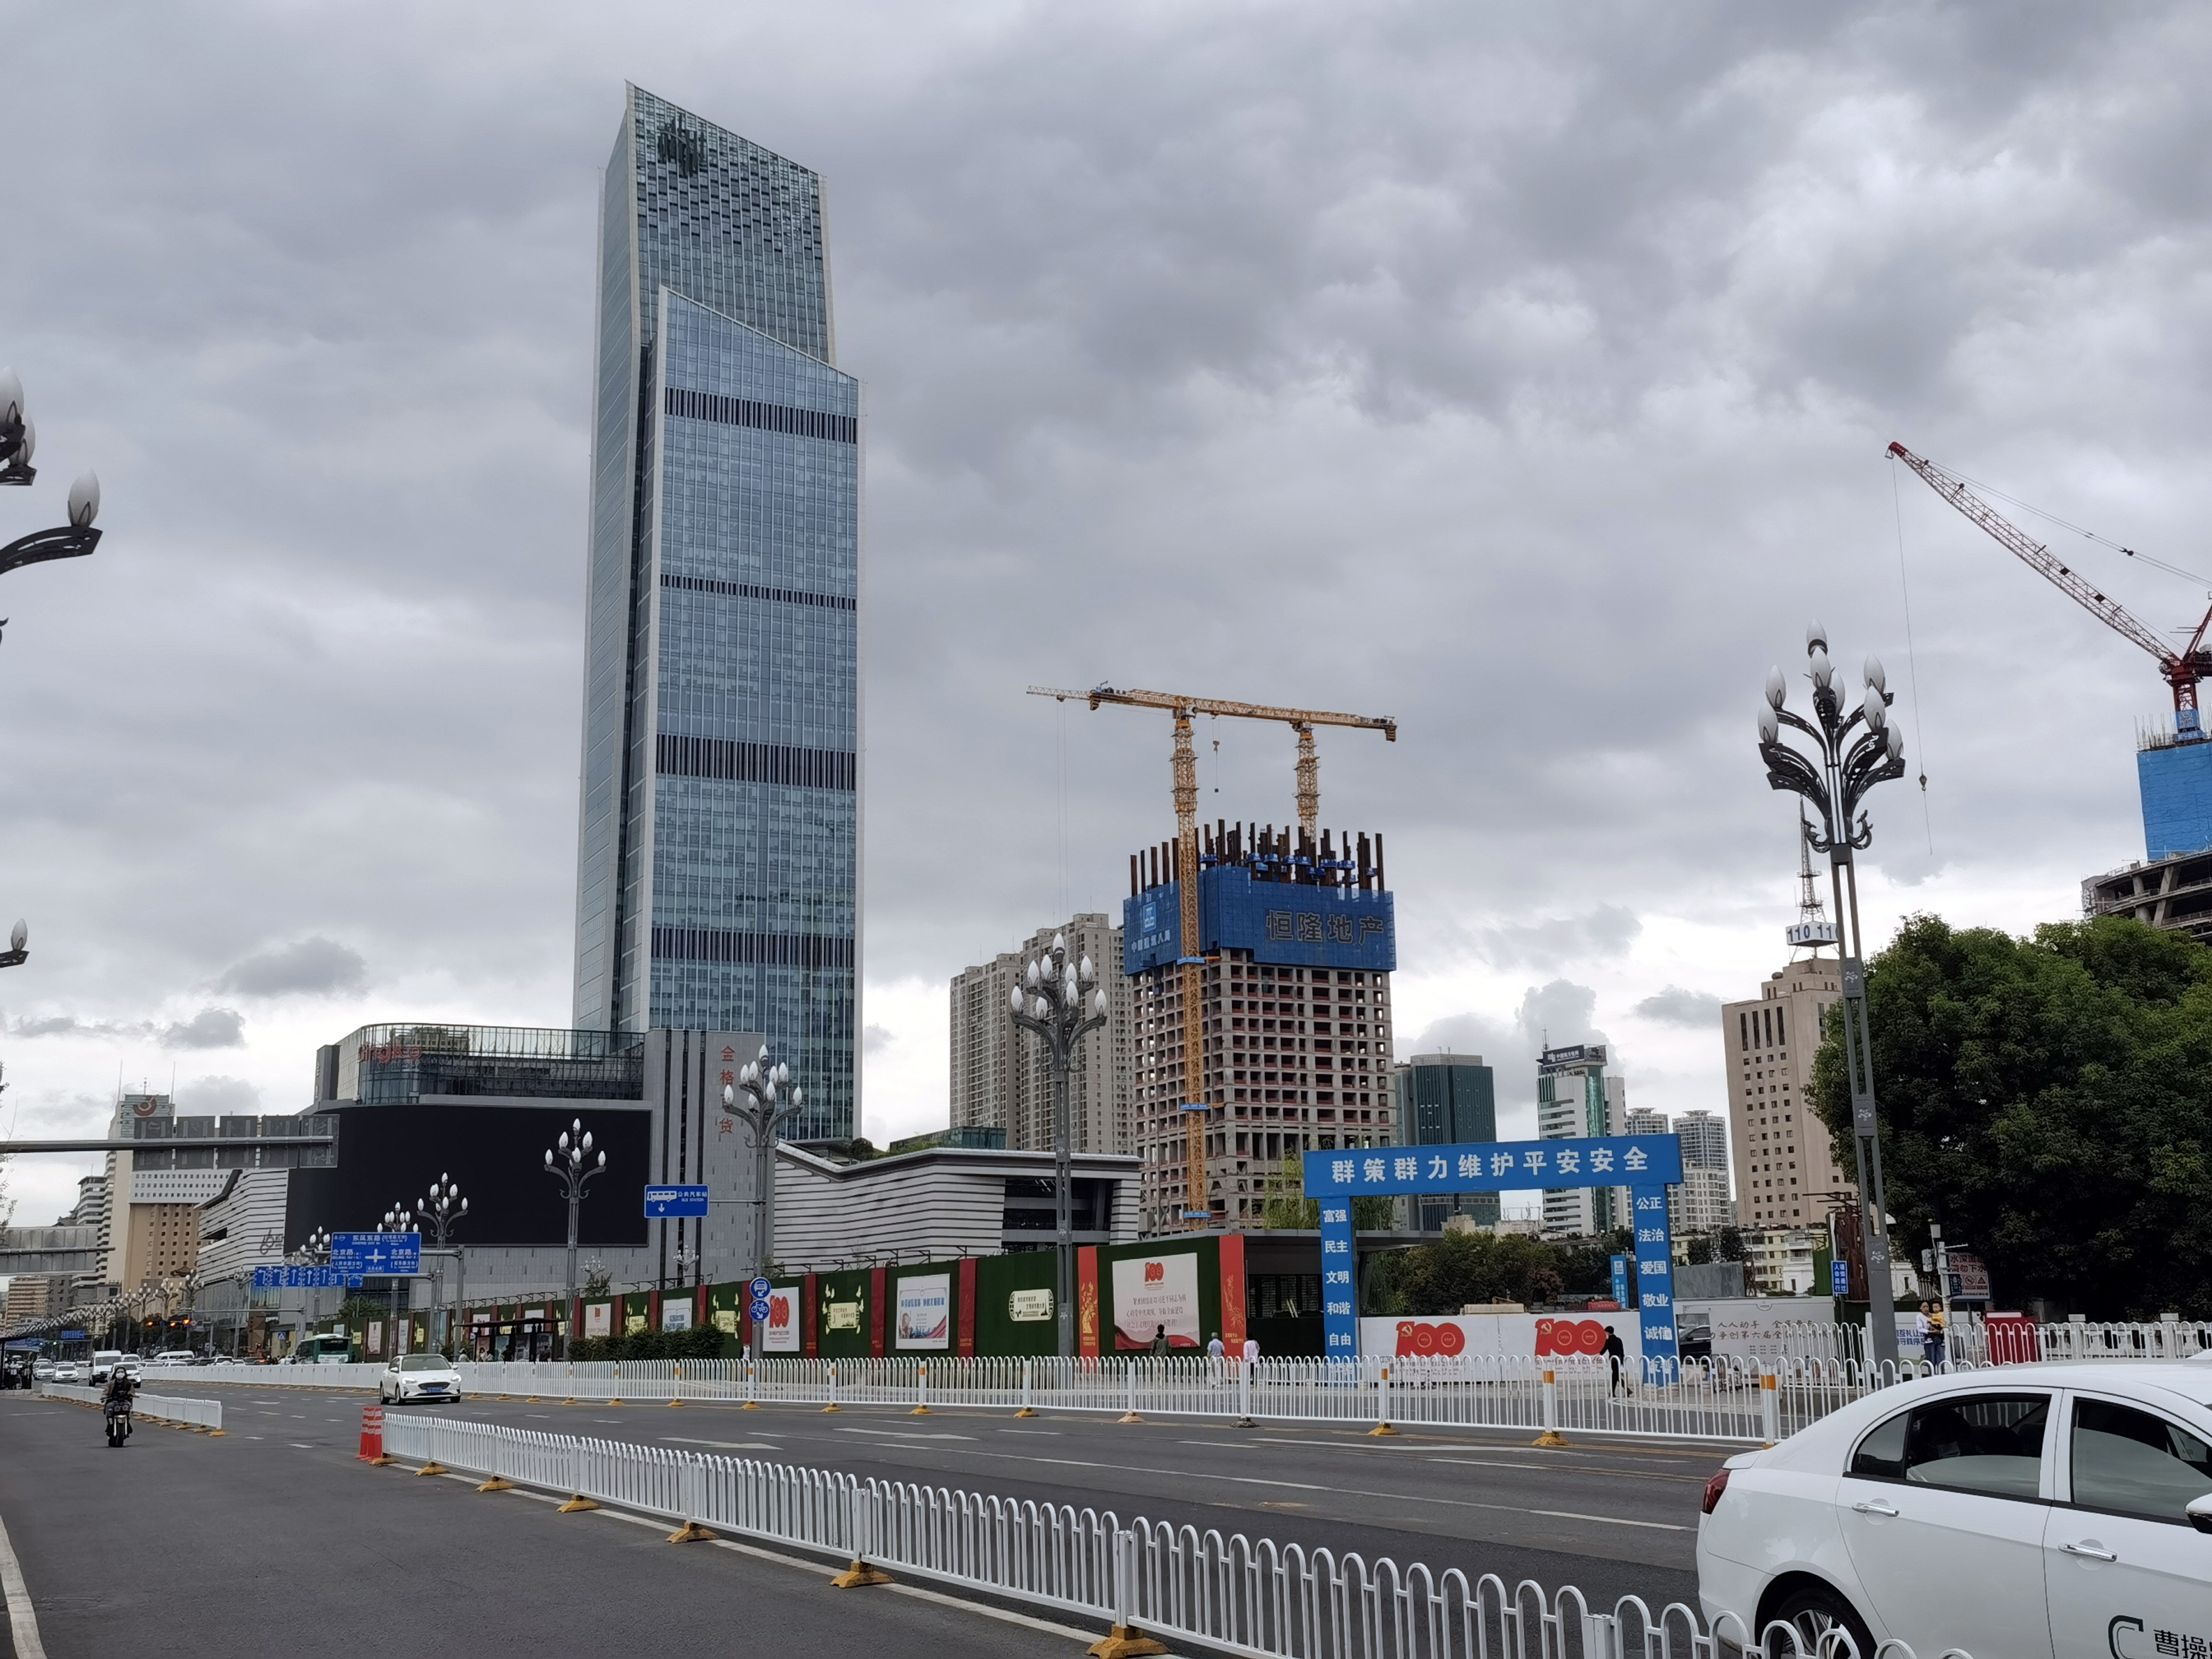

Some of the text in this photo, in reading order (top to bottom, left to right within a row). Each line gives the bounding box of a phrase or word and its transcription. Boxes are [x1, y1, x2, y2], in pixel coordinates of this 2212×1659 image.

[1266, 910, 1384, 945] 恒隆地产
[1788, 925, 1811, 942] 110
[719, 1045, 736, 1134] 金格货
[1332, 1146, 1648, 1184] 群策群力维护平安安全
[1636, 1197, 1663, 1210] 公正
[1322, 1210, 1347, 1223] 富强
[1638, 1228, 1665, 1242] 法治
[1324, 1240, 1349, 1253] 民主
[1640, 1261, 1667, 1275] 爱国
[1326, 1271, 1349, 1284] 文明
[1642, 1293, 1669, 1307] 敬业
[1327, 1302, 1351, 1315] 和谐
[1329, 1333, 1352, 1346] 自由
[1644, 1326, 1673, 1341] 诚信
[2153, 1629, 2212, 1659] 曹操
